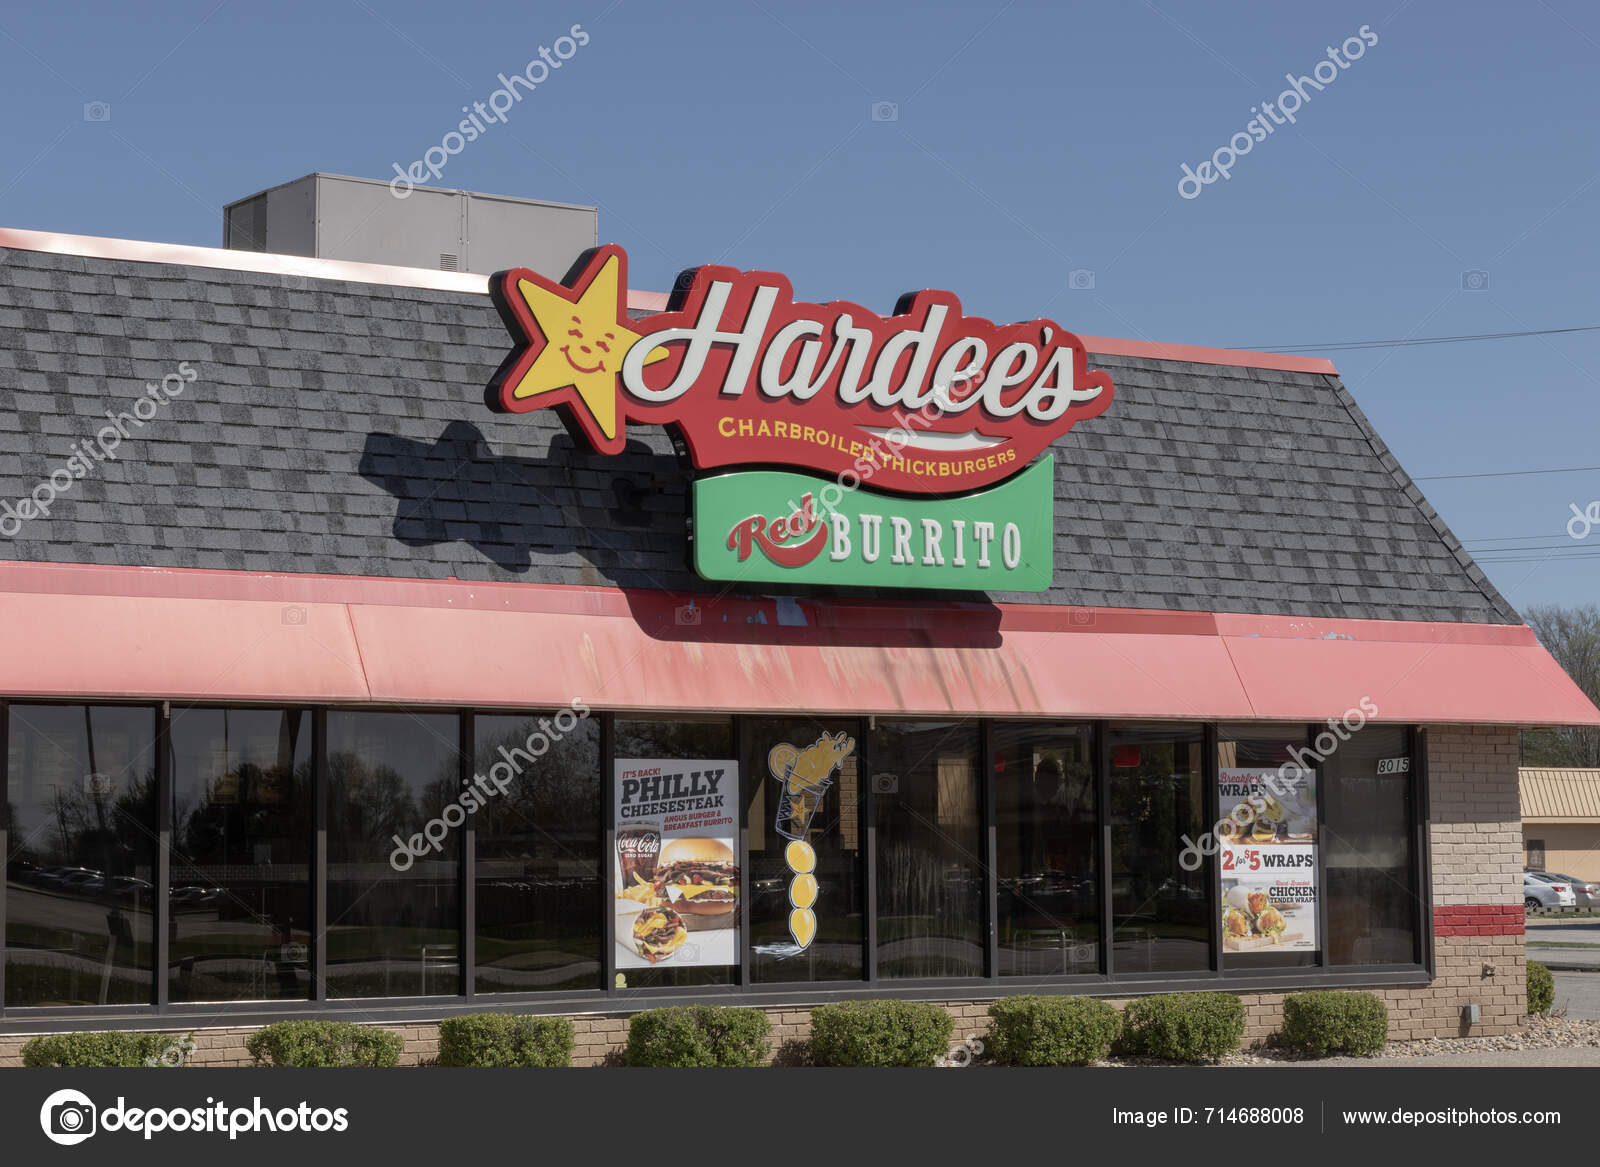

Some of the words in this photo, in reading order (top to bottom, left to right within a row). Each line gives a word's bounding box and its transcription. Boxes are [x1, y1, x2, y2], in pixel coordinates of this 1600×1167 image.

[622, 280, 1103, 421] Hardee's
[718, 416, 875, 462] CHARBROILED
[879, 449, 1016, 477] THICKBURGERS
[728, 492, 829, 568] Red
[830, 512, 1022, 570] BURRITO
[1379, 759, 1409, 773] 8015
[621, 769, 725, 804] PHILLY
[621, 796, 724, 818] CHEESESTEAK
[1222, 850, 1235, 870] 2
[1263, 854, 1313, 868] WRAPS
[1269, 886, 1317, 897] CHICKEN
